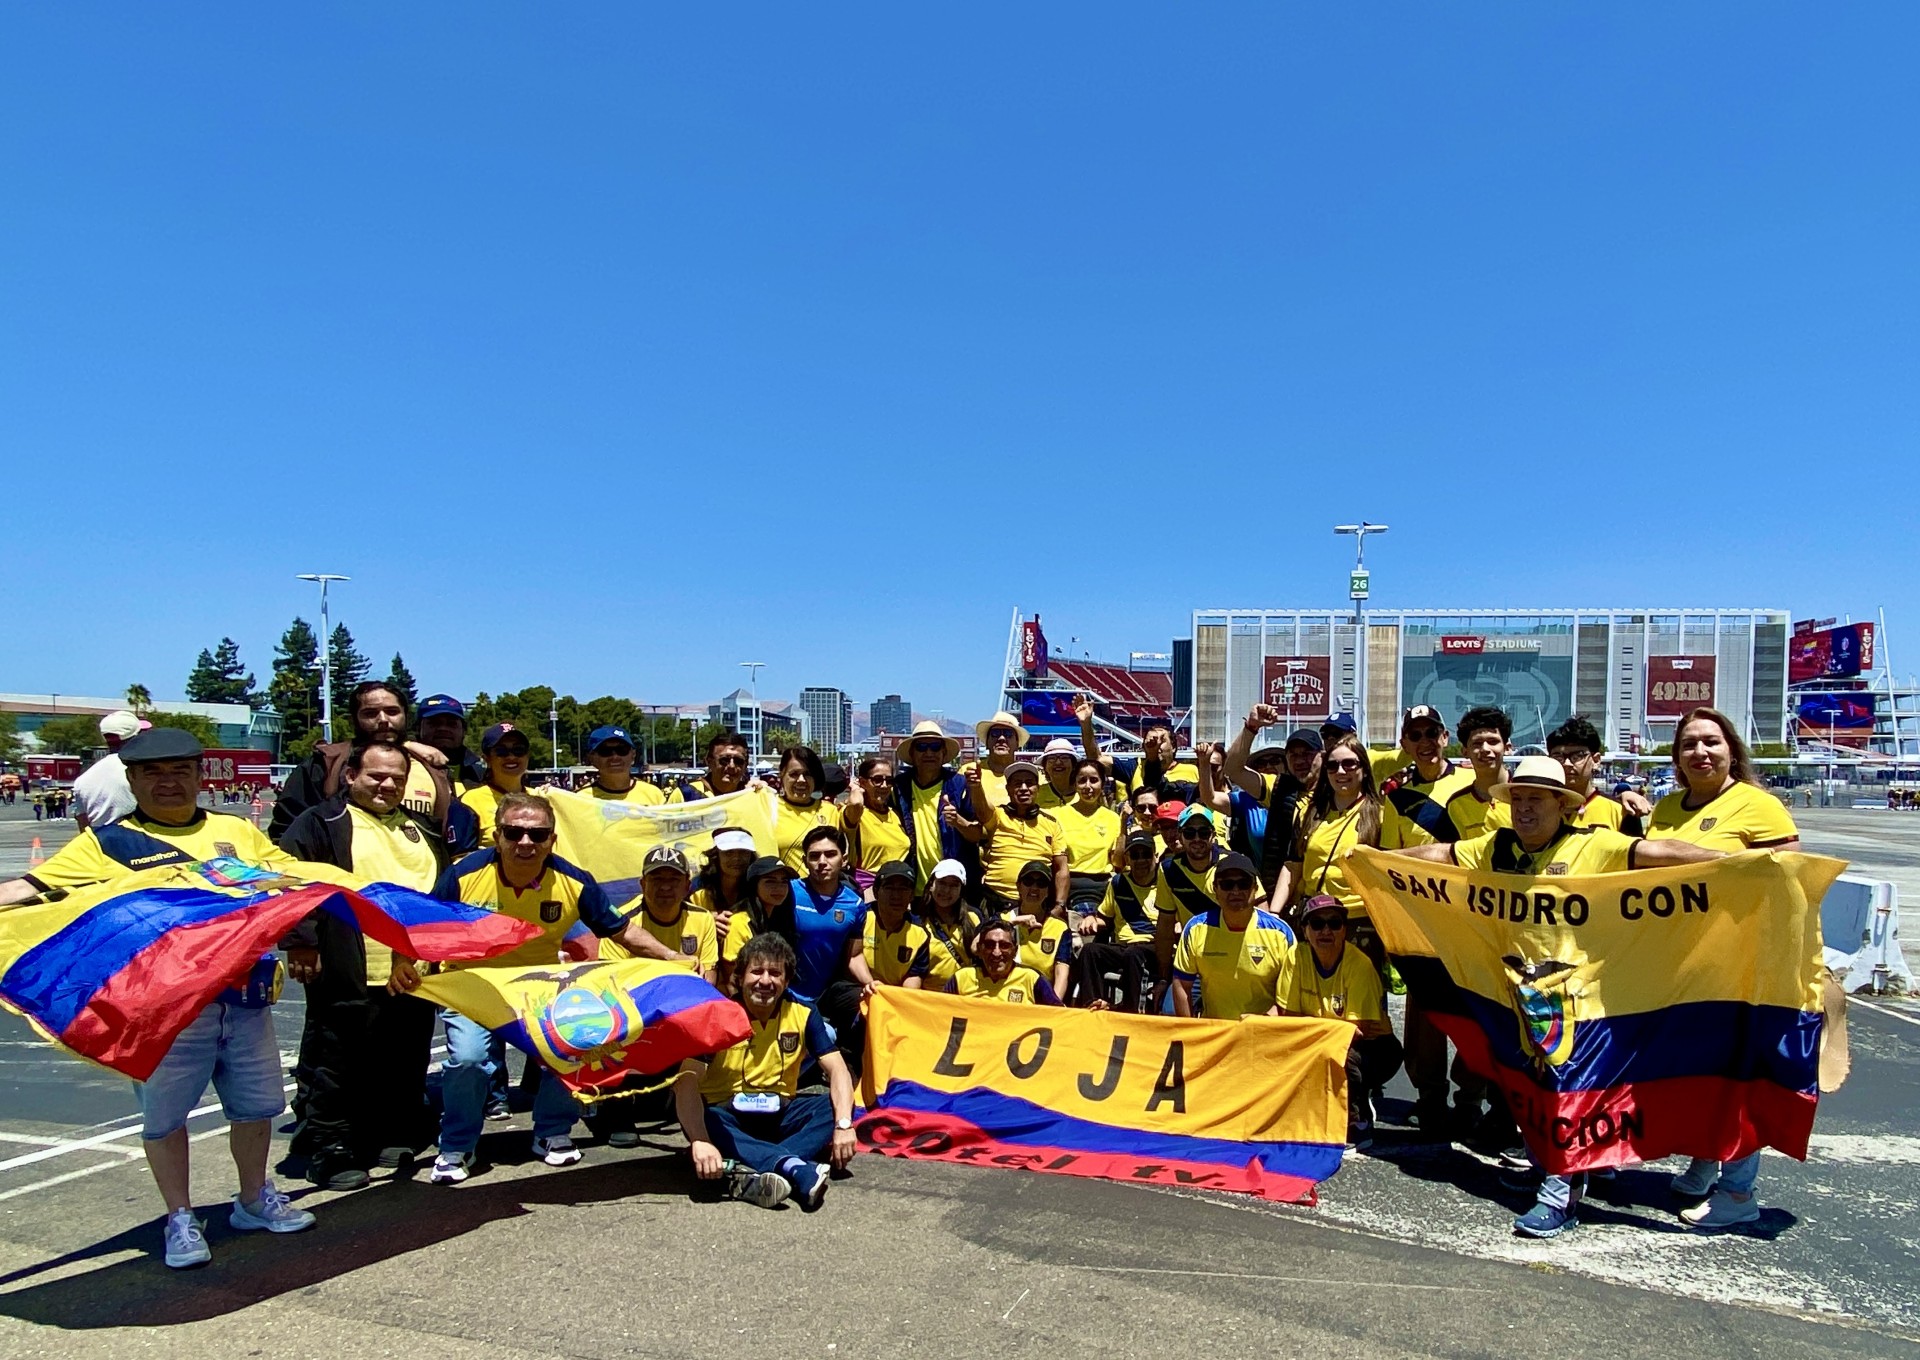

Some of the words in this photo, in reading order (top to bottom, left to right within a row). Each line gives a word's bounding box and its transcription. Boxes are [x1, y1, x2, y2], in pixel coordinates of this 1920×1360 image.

[1352, 579, 1368, 589] 26
[1487, 639, 1537, 649] STADIUM
[1270, 673, 1324, 693] FAITHFUL
[1651, 681, 1711, 701] 49ERS
[1270, 693, 1296, 705] THE
[1298, 693, 1324, 705] BAY
[130, 850, 179, 866] marathon
[1387, 868, 1452, 905] SAN
[1467, 882, 1590, 927] ISIDRO
[1619, 882, 1710, 921] CON
[931, 1016, 1187, 1114] LOJA
